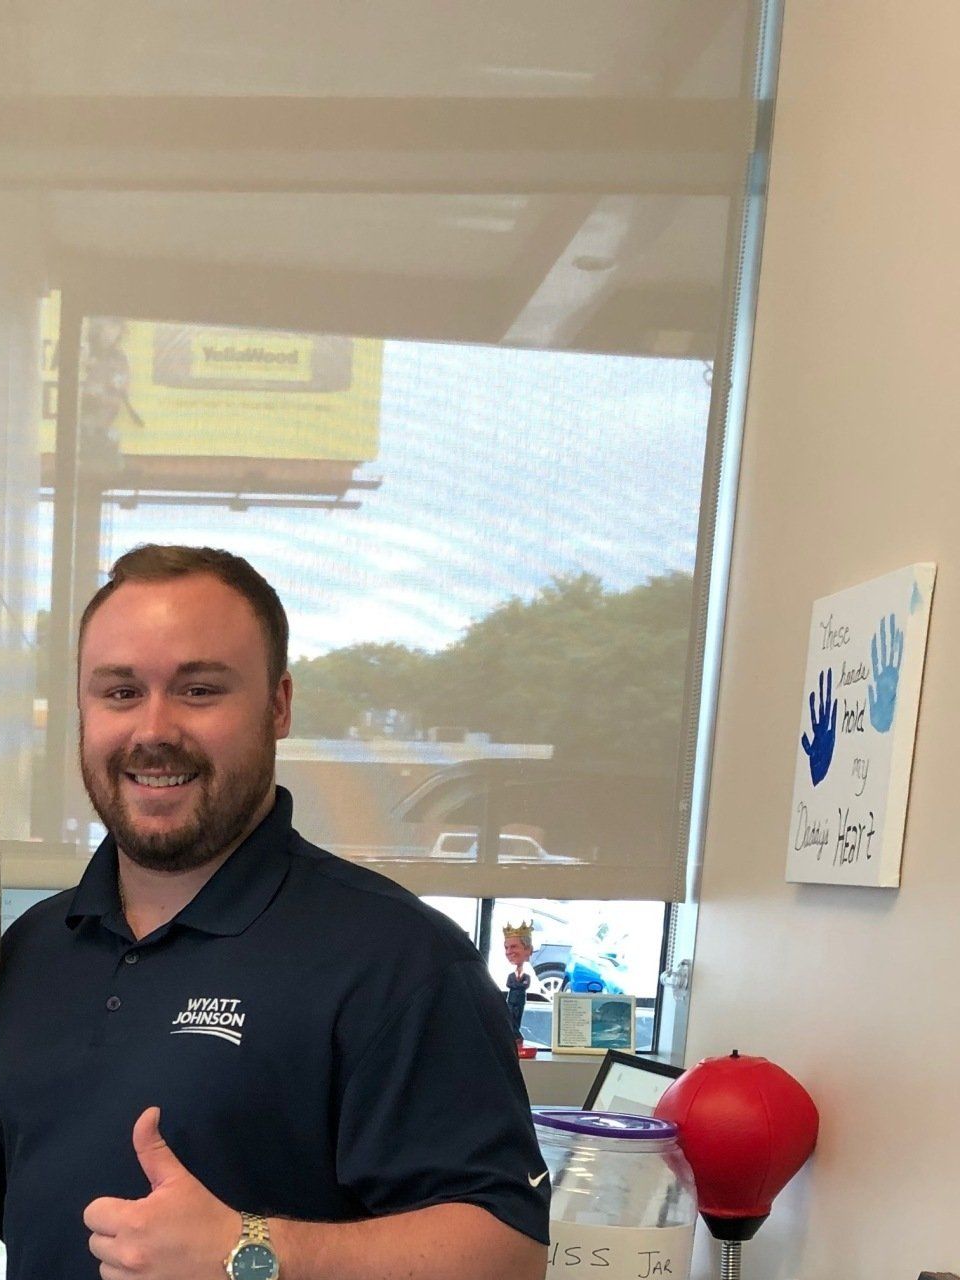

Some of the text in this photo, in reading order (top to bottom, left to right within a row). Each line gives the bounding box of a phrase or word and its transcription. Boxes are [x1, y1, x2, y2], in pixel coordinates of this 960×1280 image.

[820, 613, 851, 650] These
[836, 660, 870, 689] hands
[841, 698, 866, 734] hold
[851, 757, 870, 797] my
[172, 1011, 246, 1027] JOHNSON
[187, 998, 242, 1012] WYATT
